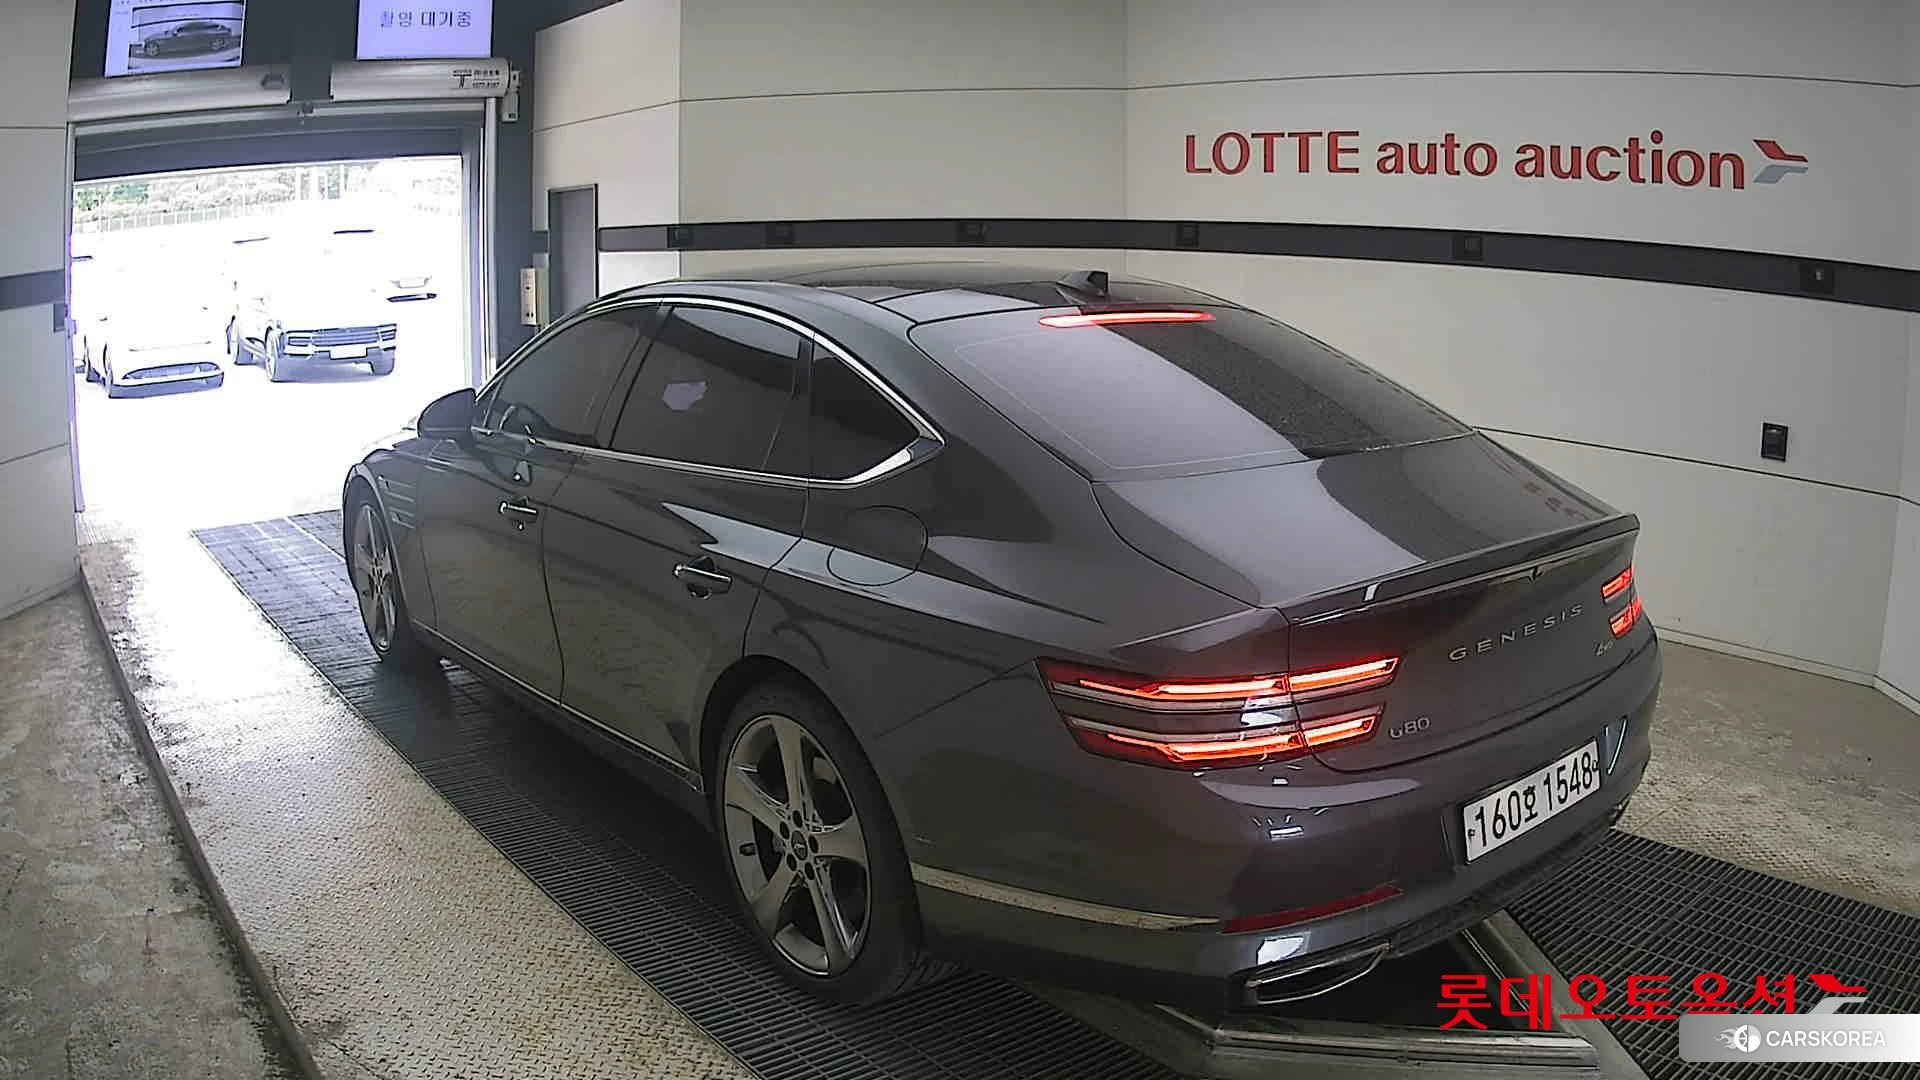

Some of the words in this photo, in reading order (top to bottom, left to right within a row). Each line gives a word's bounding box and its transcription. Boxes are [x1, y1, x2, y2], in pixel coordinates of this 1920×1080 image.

[421, 10, 472, 28] 대기중
[1185, 131, 1360, 175] LOTTE
[1376, 132, 1499, 177] auto
[1514, 129, 1745, 190] auction
[1448, 603, 1584, 661] GENESIS
[1474, 784, 1539, 847] 160호
[1543, 751, 1593, 811] 1548
